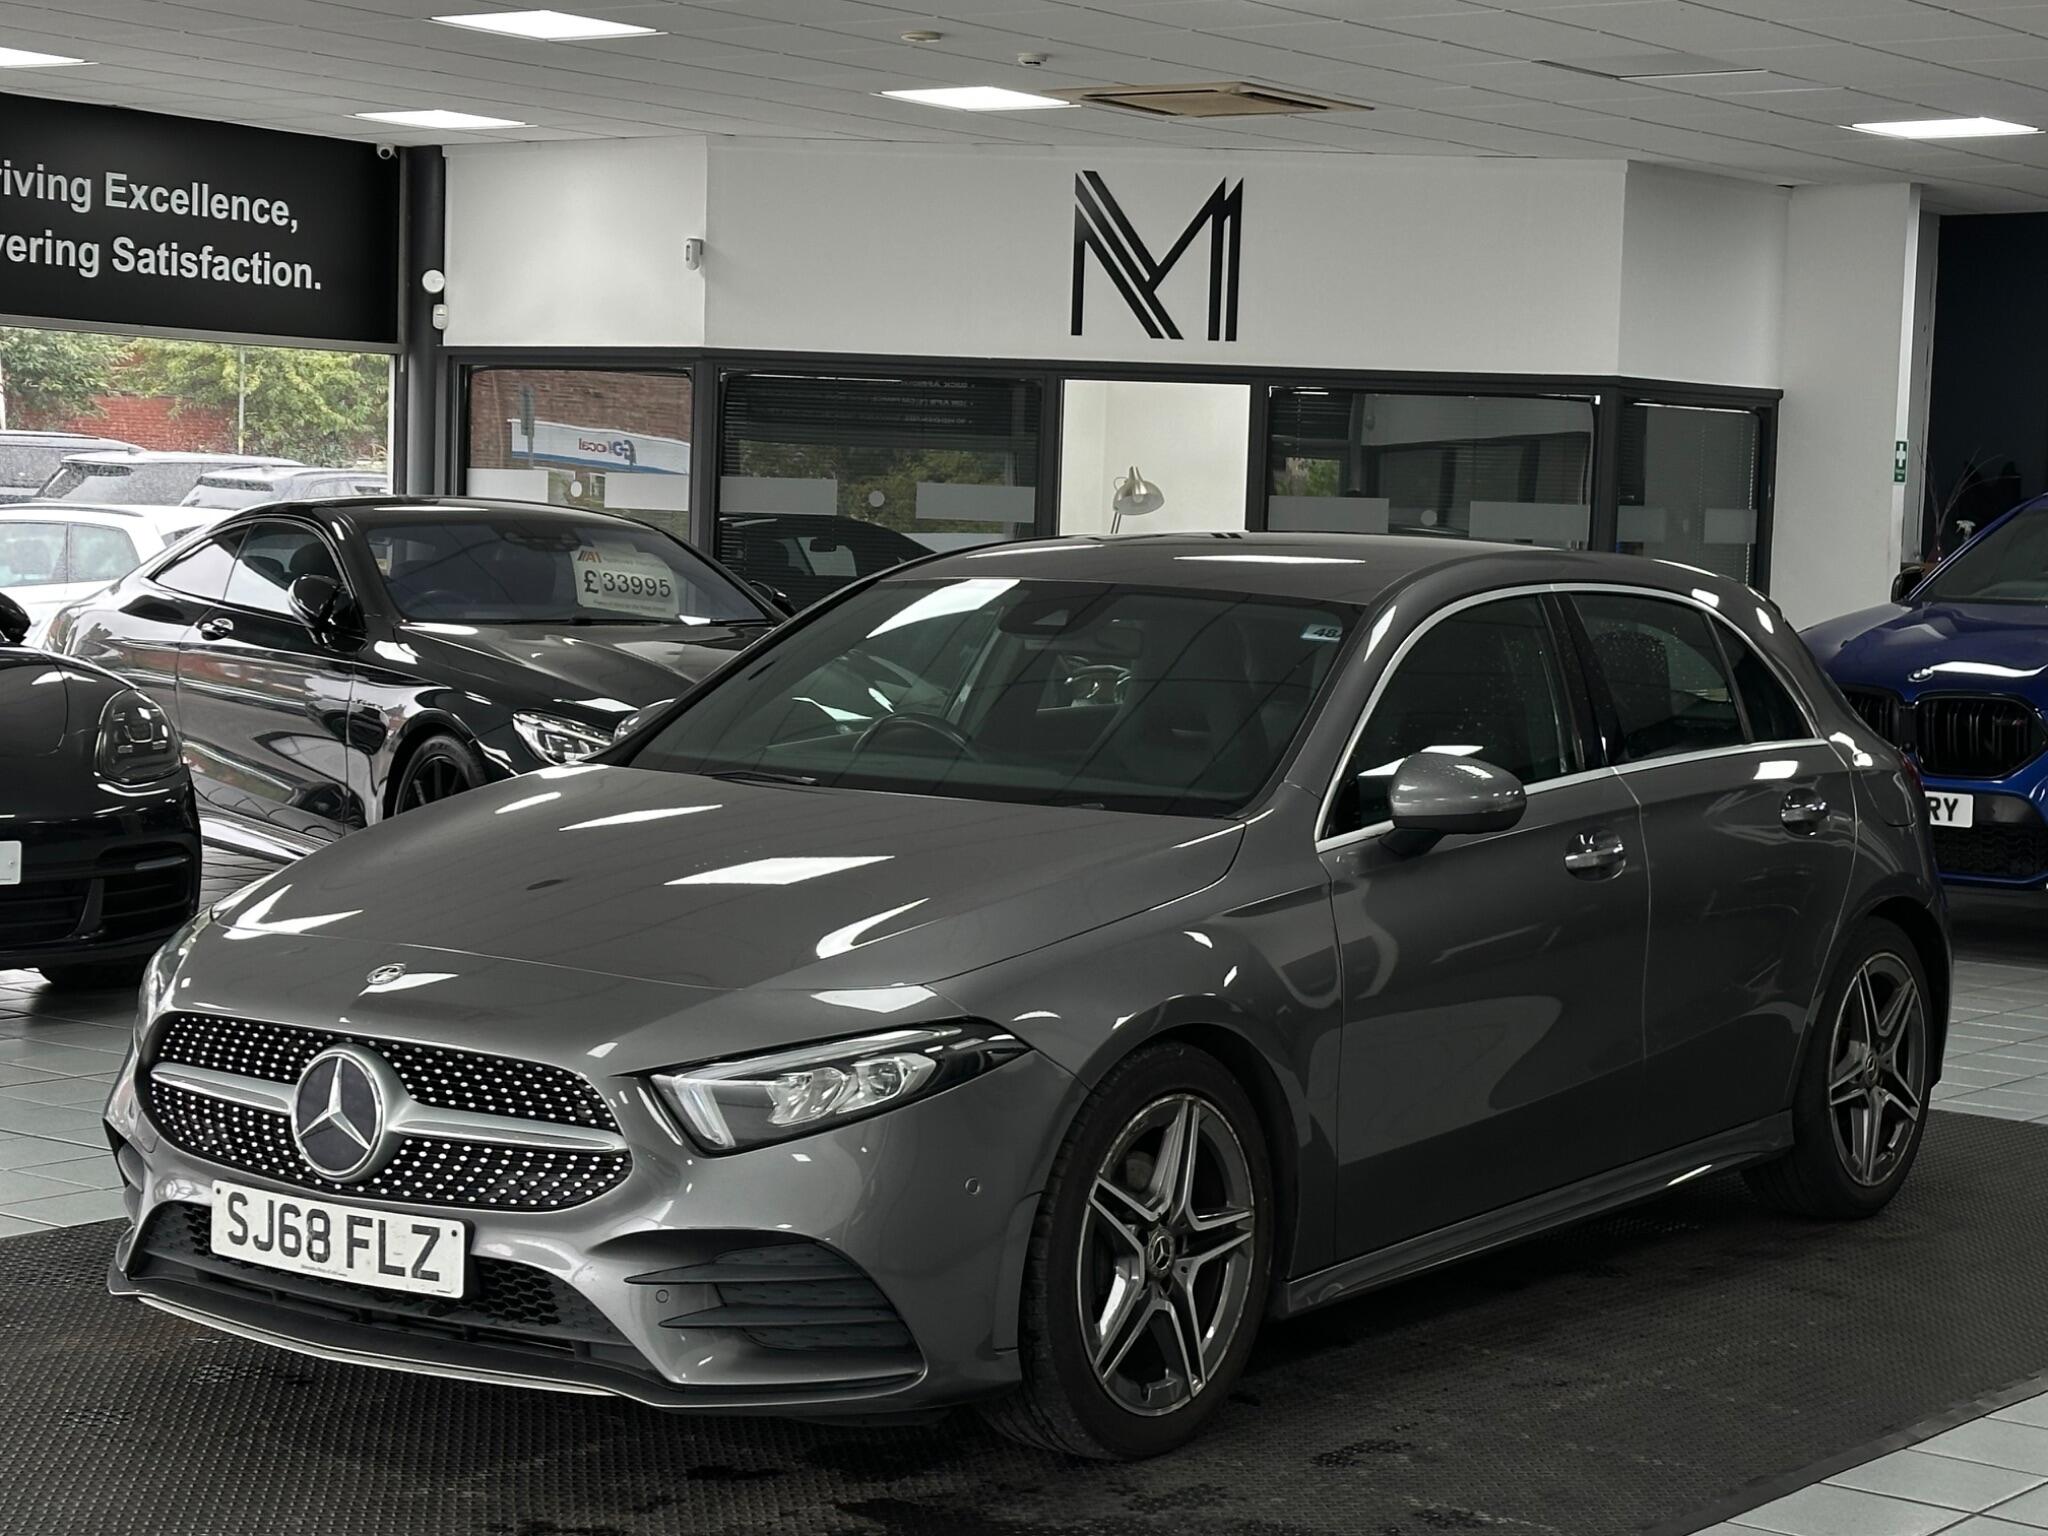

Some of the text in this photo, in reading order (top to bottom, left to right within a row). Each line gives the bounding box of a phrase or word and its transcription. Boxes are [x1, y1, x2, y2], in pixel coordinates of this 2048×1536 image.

[0, 159, 298, 233] iving Excellence,
[0, 229, 322, 290] ering Satisfaction.
[583, 569, 672, 598] £33995
[227, 1191, 441, 1282] SJ68 FLZ
